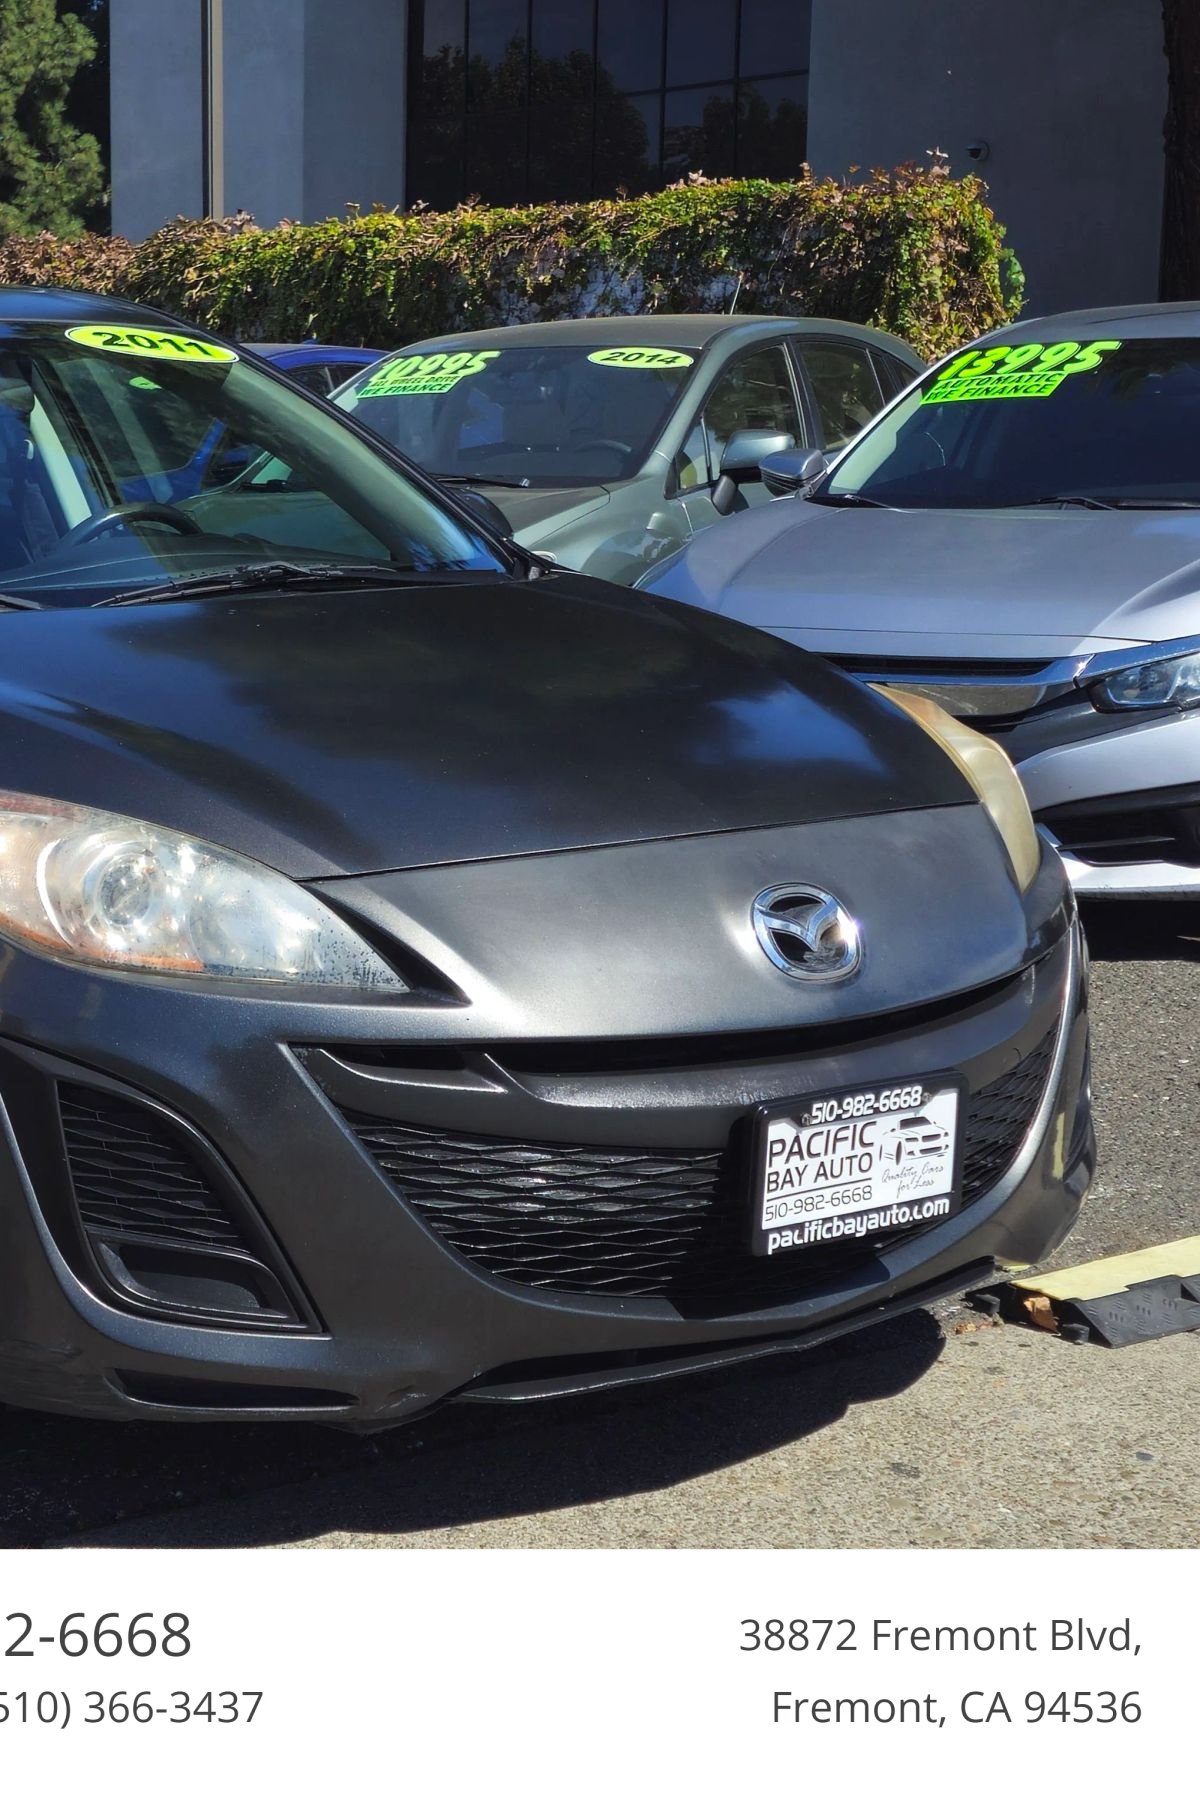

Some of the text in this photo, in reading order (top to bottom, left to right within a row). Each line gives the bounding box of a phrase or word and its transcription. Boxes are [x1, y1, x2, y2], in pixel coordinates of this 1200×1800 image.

[92, 331, 214, 358] 2011
[599, 351, 681, 365] 2014
[368, 351, 501, 381] 10995
[937, 341, 1122, 382] 13995
[384, 383, 453, 395] FINANCE
[935, 372, 1063, 390] AUTOMATIC
[958, 383, 1052, 399] FINANCE
[810, 1085, 923, 1125] 510-982-6668
[768, 1120, 877, 1169] PACIFIC
[766, 1152, 873, 1194] BAY AUTO
[765, 1184, 873, 1222] 510-982-6668
